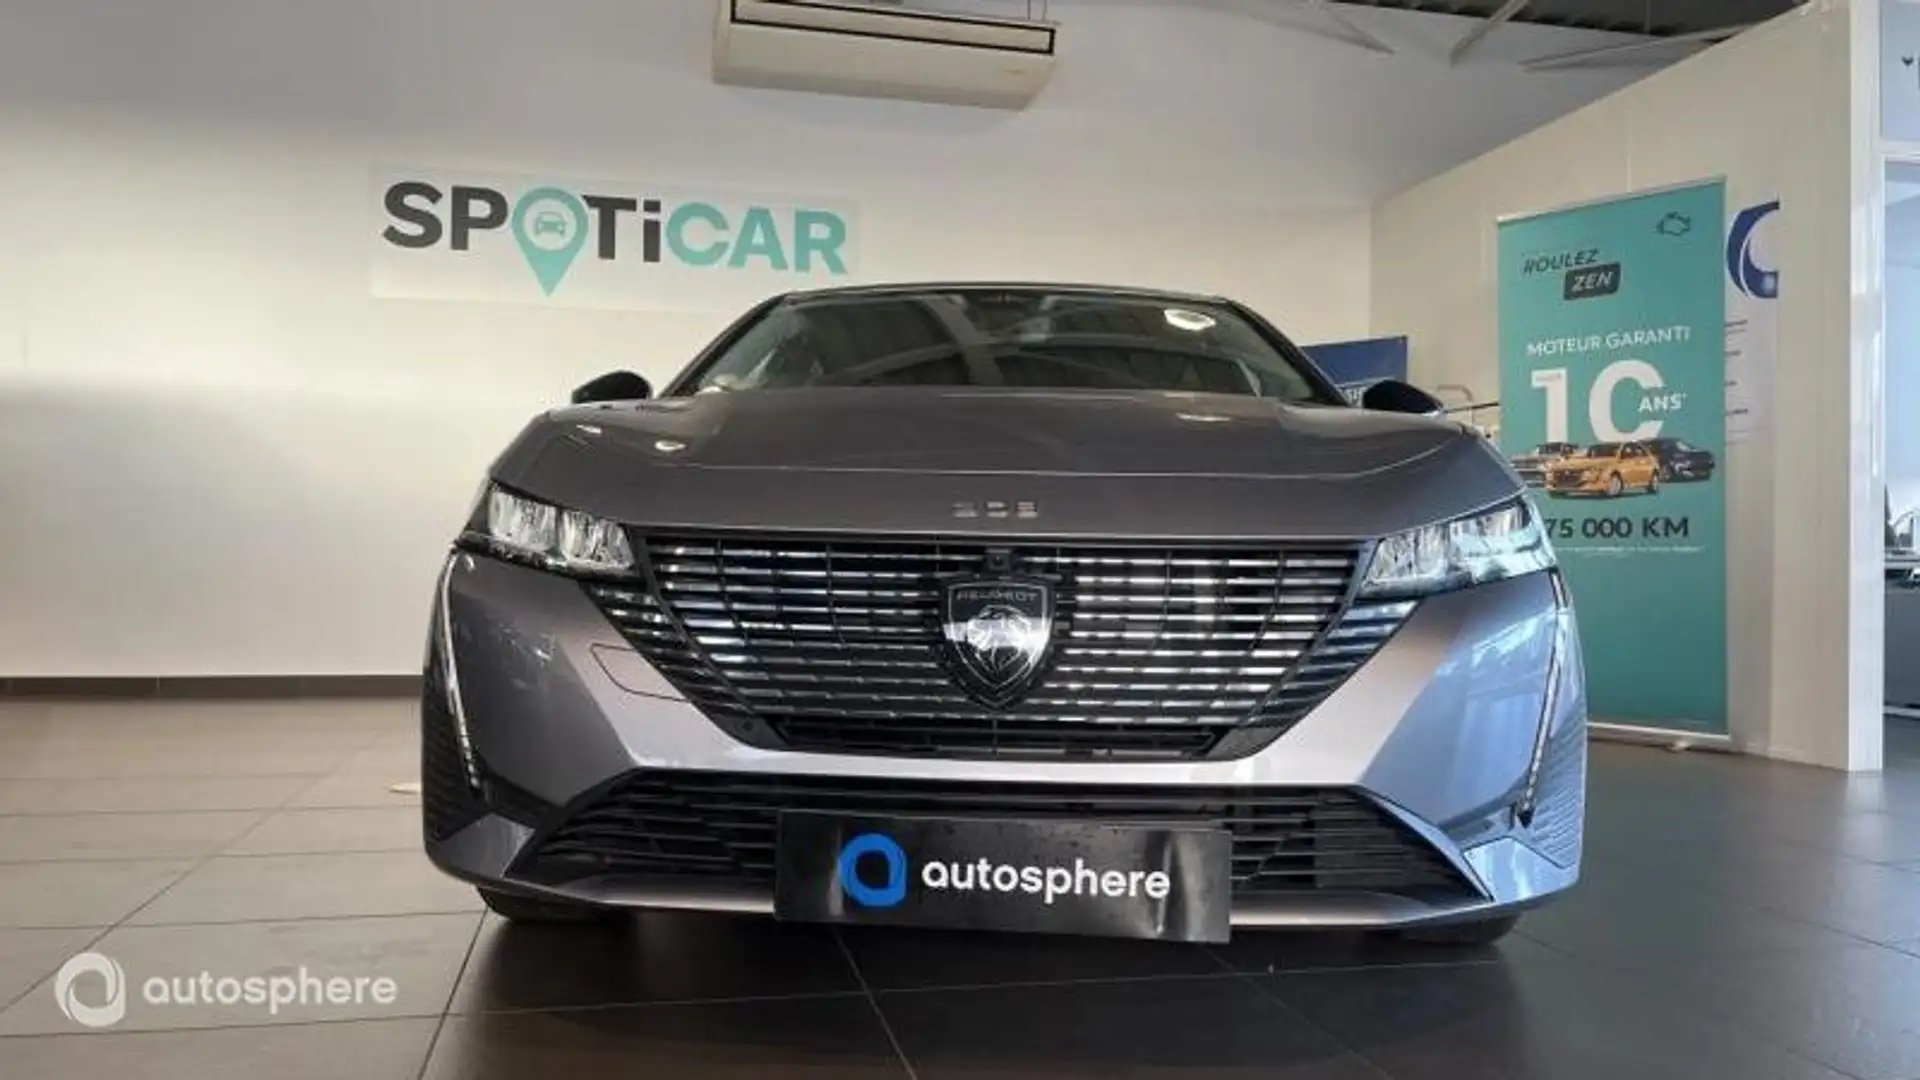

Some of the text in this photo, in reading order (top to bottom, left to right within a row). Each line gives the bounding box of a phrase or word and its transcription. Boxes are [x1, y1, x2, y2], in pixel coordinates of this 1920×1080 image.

[1523, 249, 1600, 276] ROULEZ
[1571, 271, 1615, 292] ZEN
[1526, 325, 1692, 357] MOTEUR GARANTI
[1581, 518, 1633, 538] 000
[1642, 517, 1690, 538] KM
[921, 857, 1172, 905] autosphere
